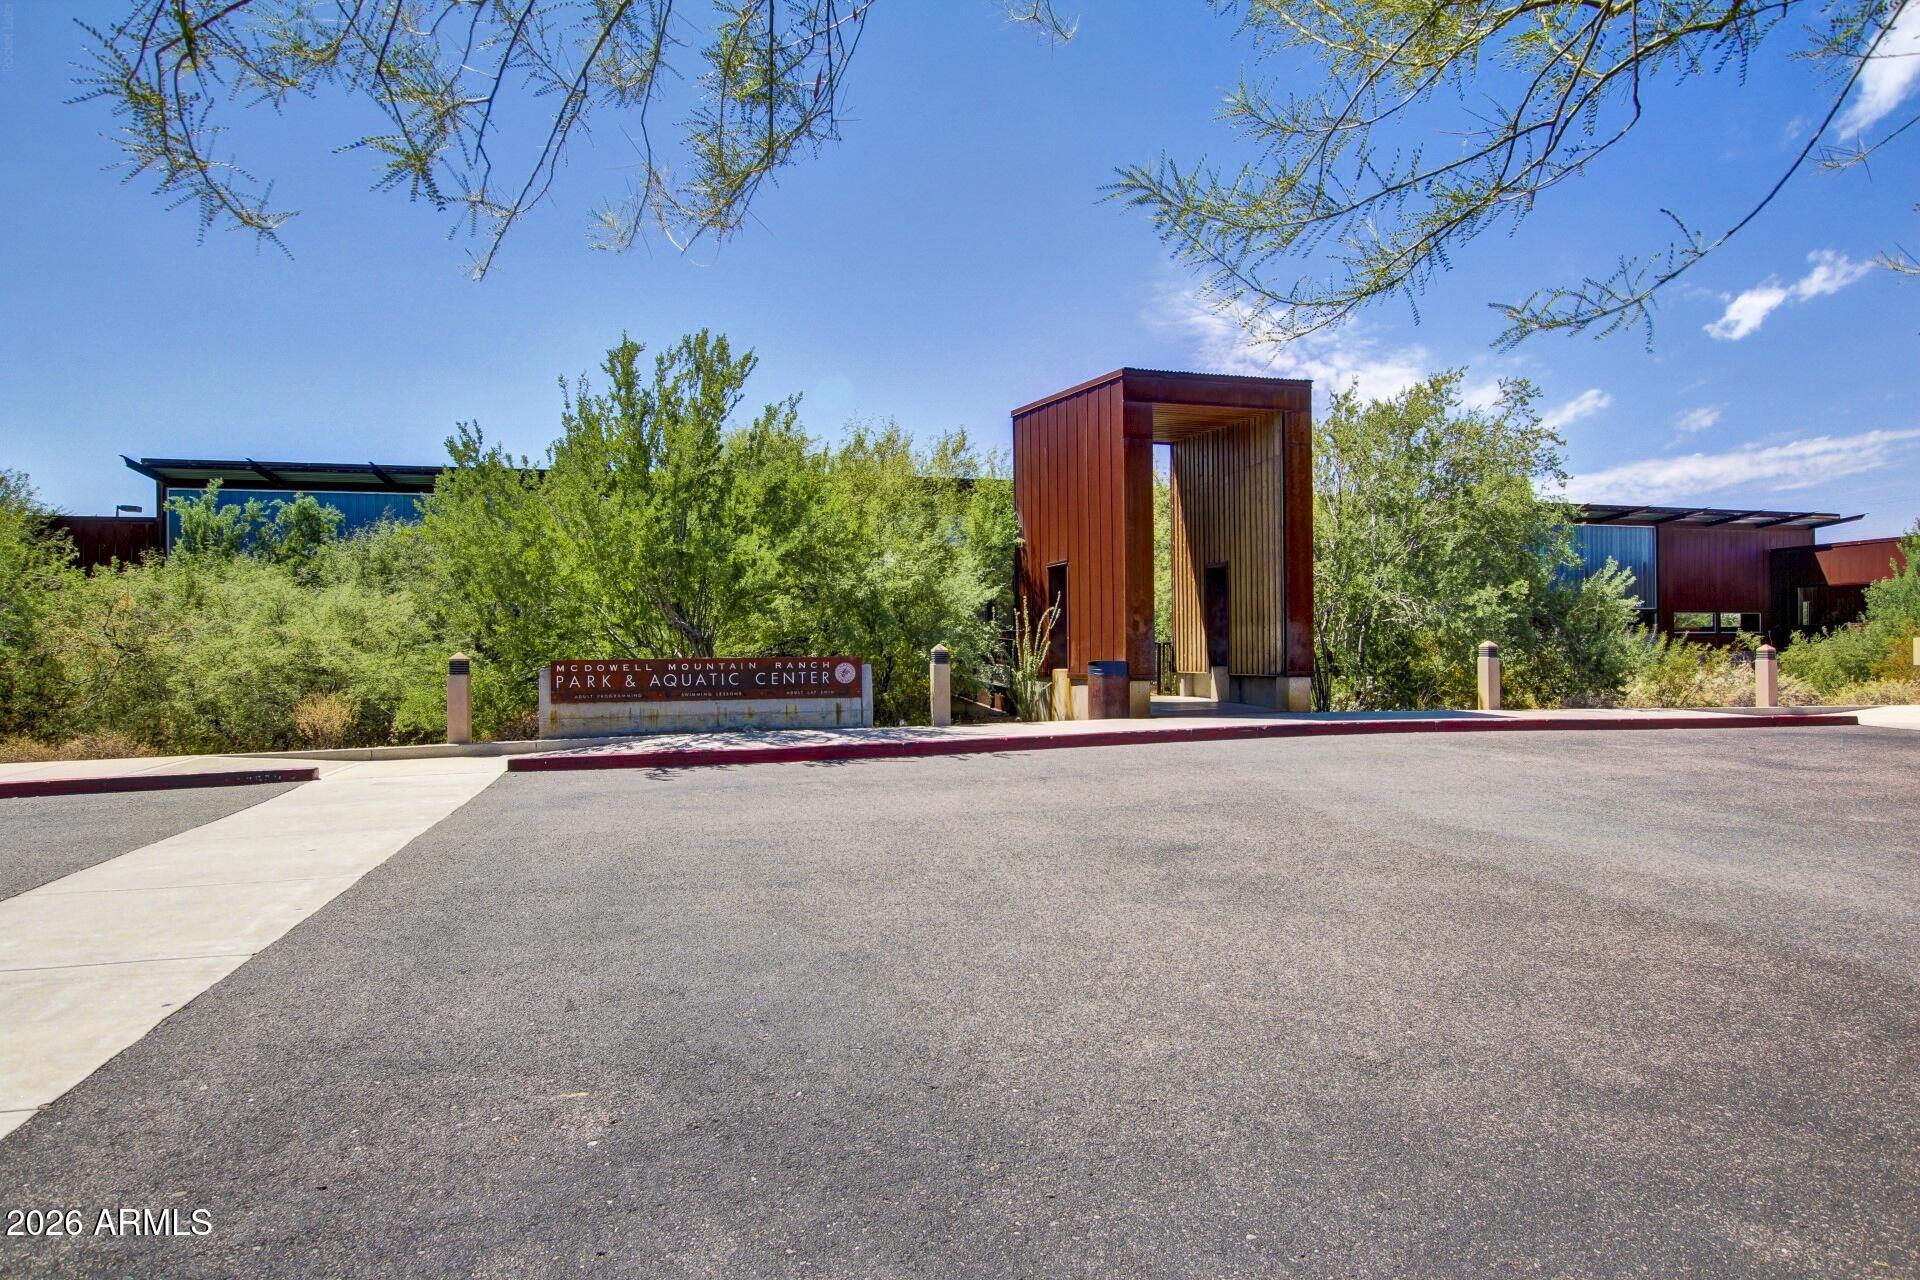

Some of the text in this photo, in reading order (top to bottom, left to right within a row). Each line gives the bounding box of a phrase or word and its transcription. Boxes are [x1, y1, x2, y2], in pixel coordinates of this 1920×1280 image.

[556, 661, 830, 672] MCDOWELL MOUNTAIN RANCH
[556, 674, 612, 689] PARK
[625, 674, 636, 688] &
[650, 672, 740, 688] AQUATIC
[755, 671, 830, 686] CENTER
